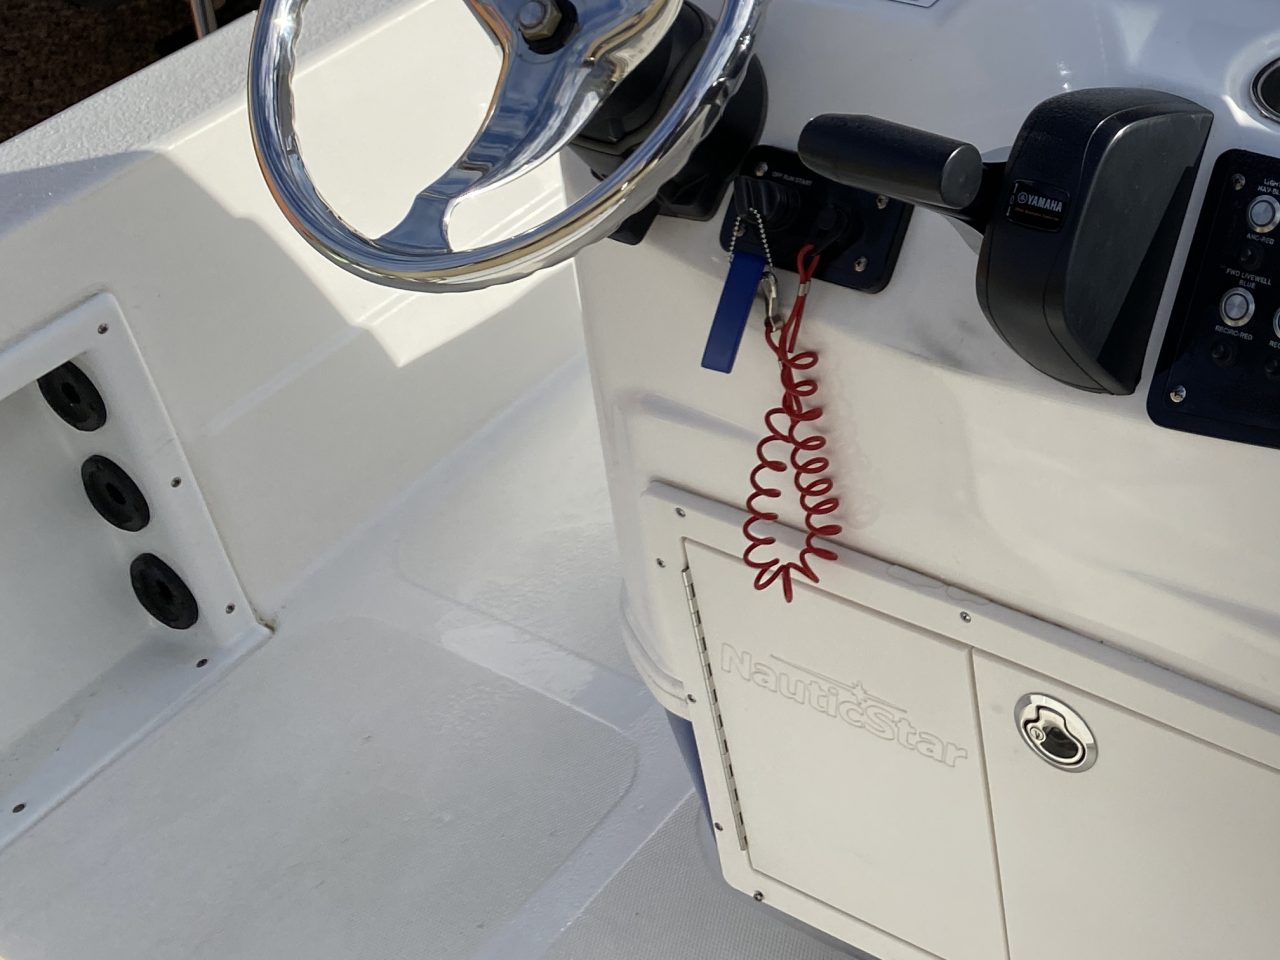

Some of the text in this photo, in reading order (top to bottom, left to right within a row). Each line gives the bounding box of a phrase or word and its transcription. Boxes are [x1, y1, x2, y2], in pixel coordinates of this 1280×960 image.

[1027, 193, 1063, 213] YAMAHA
[1225, 267, 1272, 286] FWD LIVEWELL
[1239, 279, 1256, 290] BLUE
[720, 642, 968, 768] NauticStar
